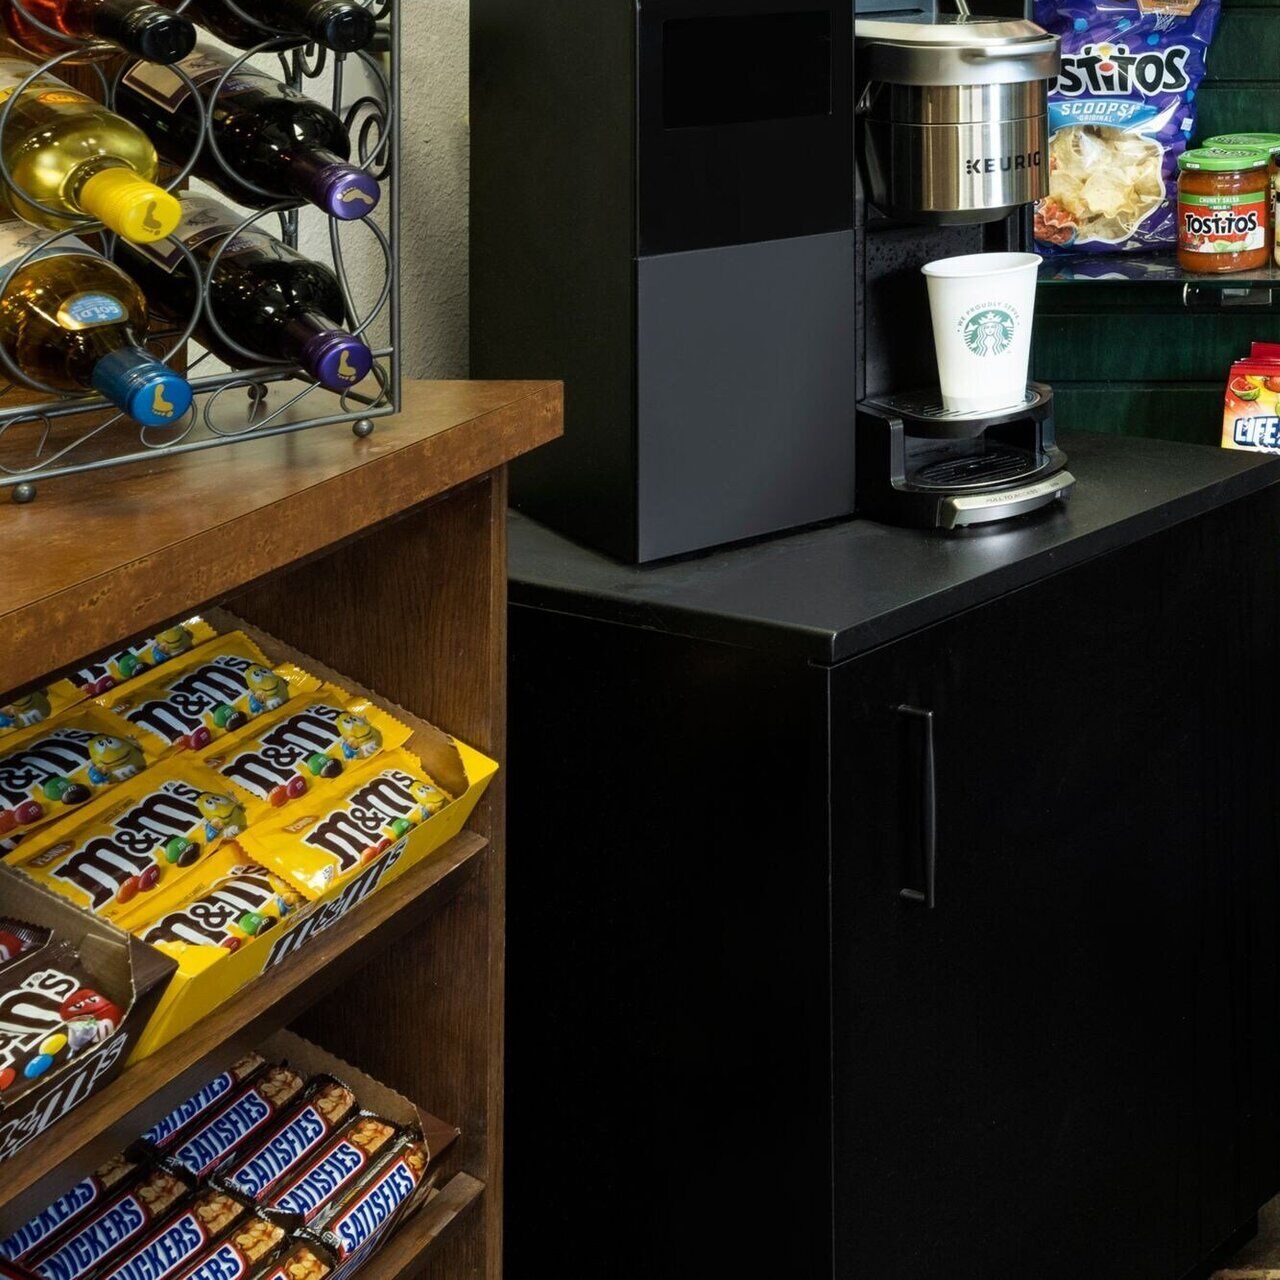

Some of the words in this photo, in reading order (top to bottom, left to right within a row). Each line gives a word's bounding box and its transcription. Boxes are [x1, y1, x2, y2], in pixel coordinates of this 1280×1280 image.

[1061, 101, 1139, 119] SCOOPS!
[177, 1089, 271, 1175] SATISFIES
[335, 1160, 416, 1255] SATISFIES
